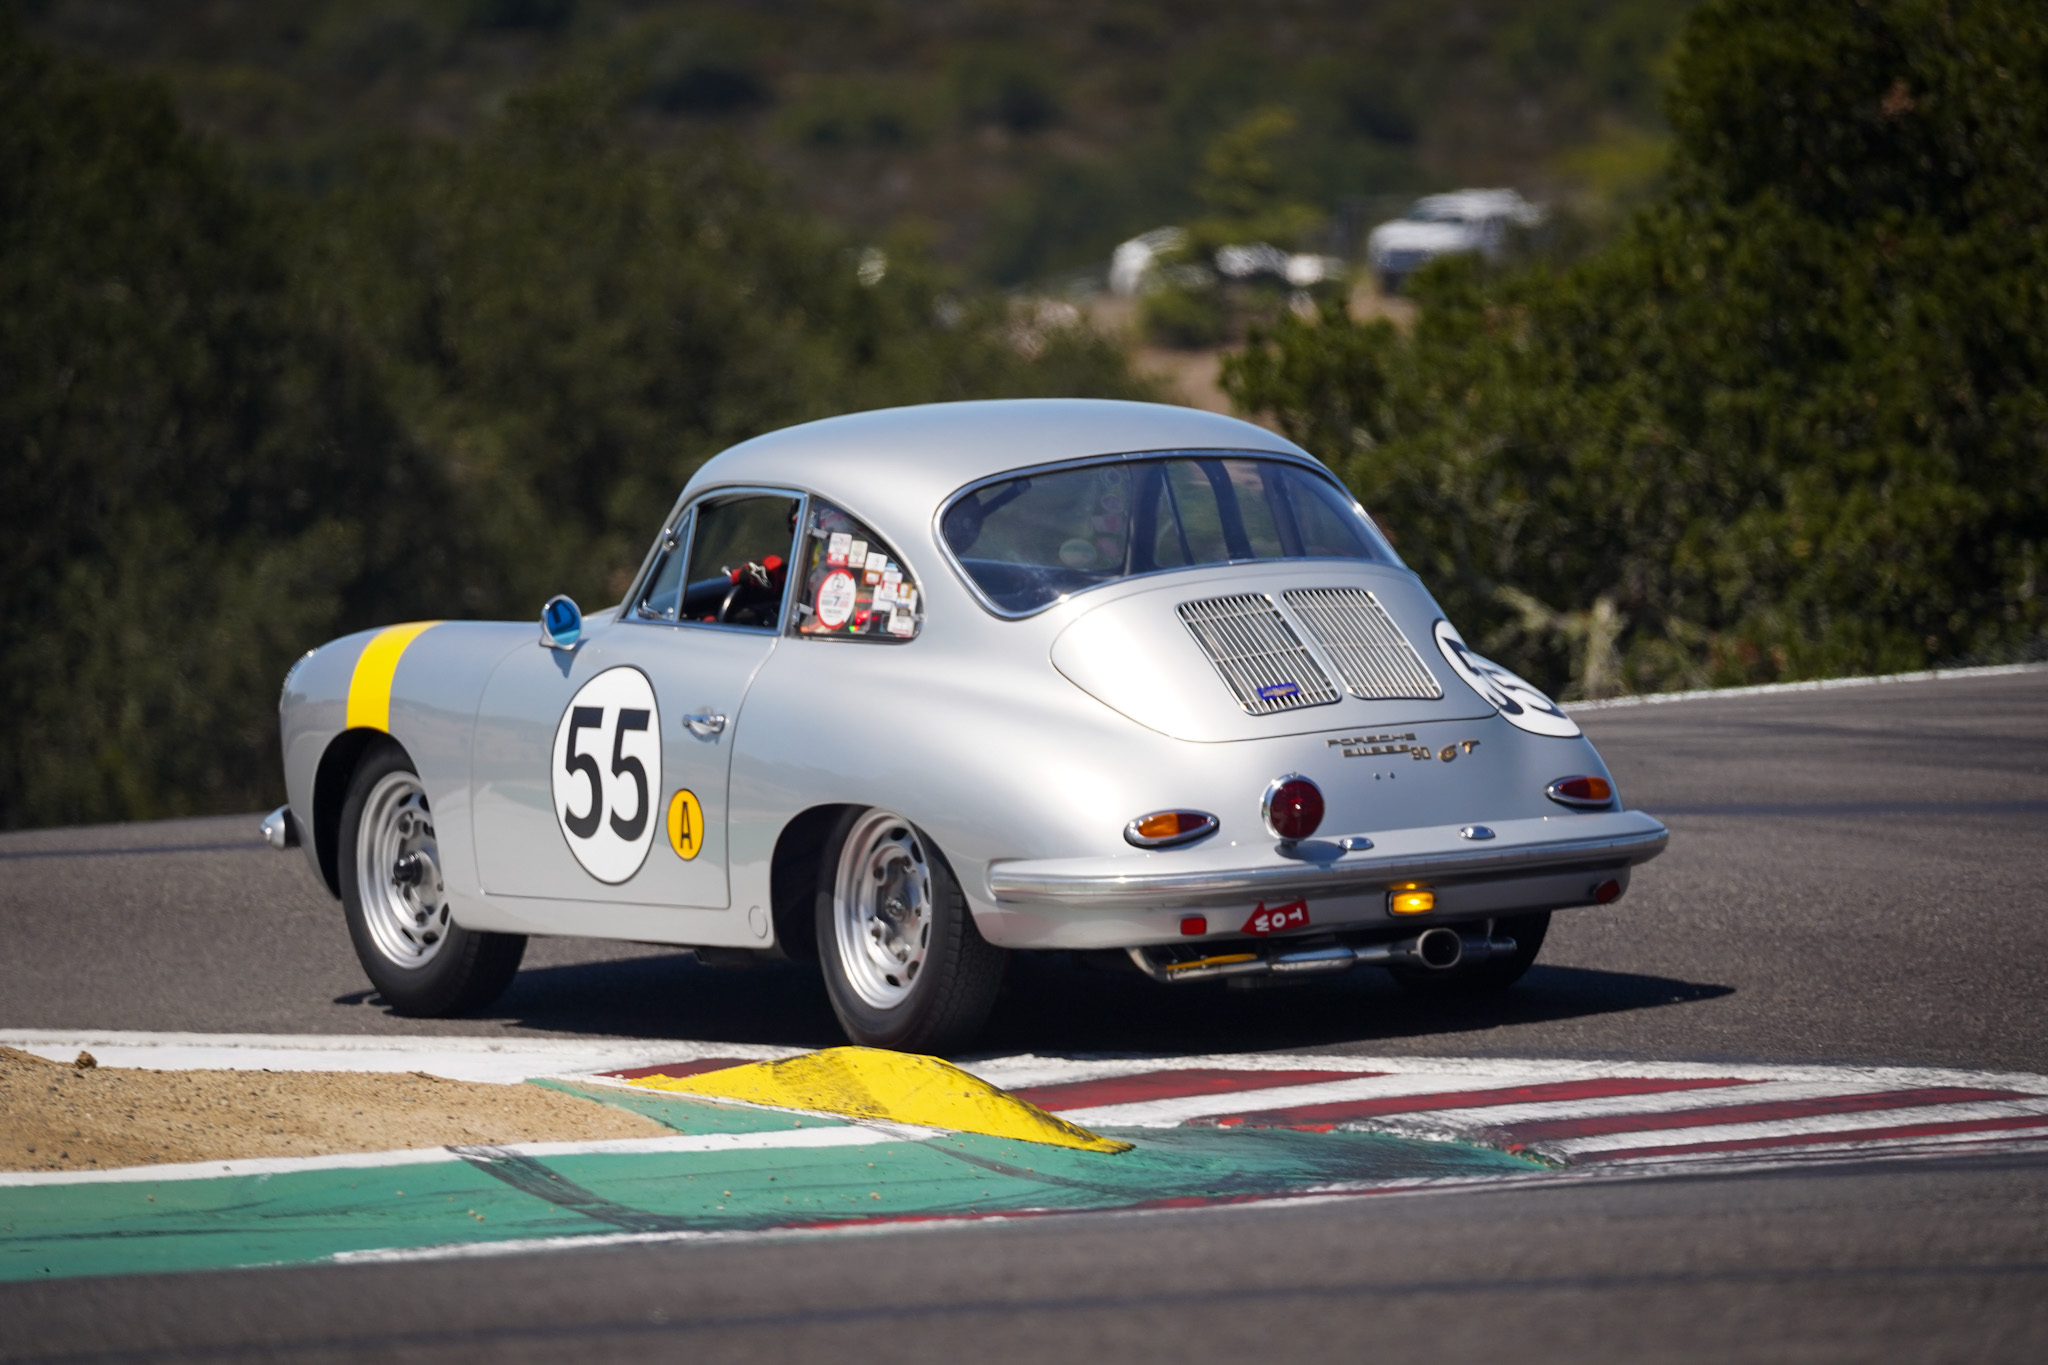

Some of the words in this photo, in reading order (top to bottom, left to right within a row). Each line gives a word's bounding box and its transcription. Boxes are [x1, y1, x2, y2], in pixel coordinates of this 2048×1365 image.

[1441, 636, 1568, 719] 55
[1326, 733, 1417, 748] PORSCHE
[1410, 746, 1432, 760] 90
[1437, 739, 1480, 763] GT
[565, 706, 650, 842] 55
[680, 801, 693, 849] A
[1254, 907, 1304, 932] TOW
